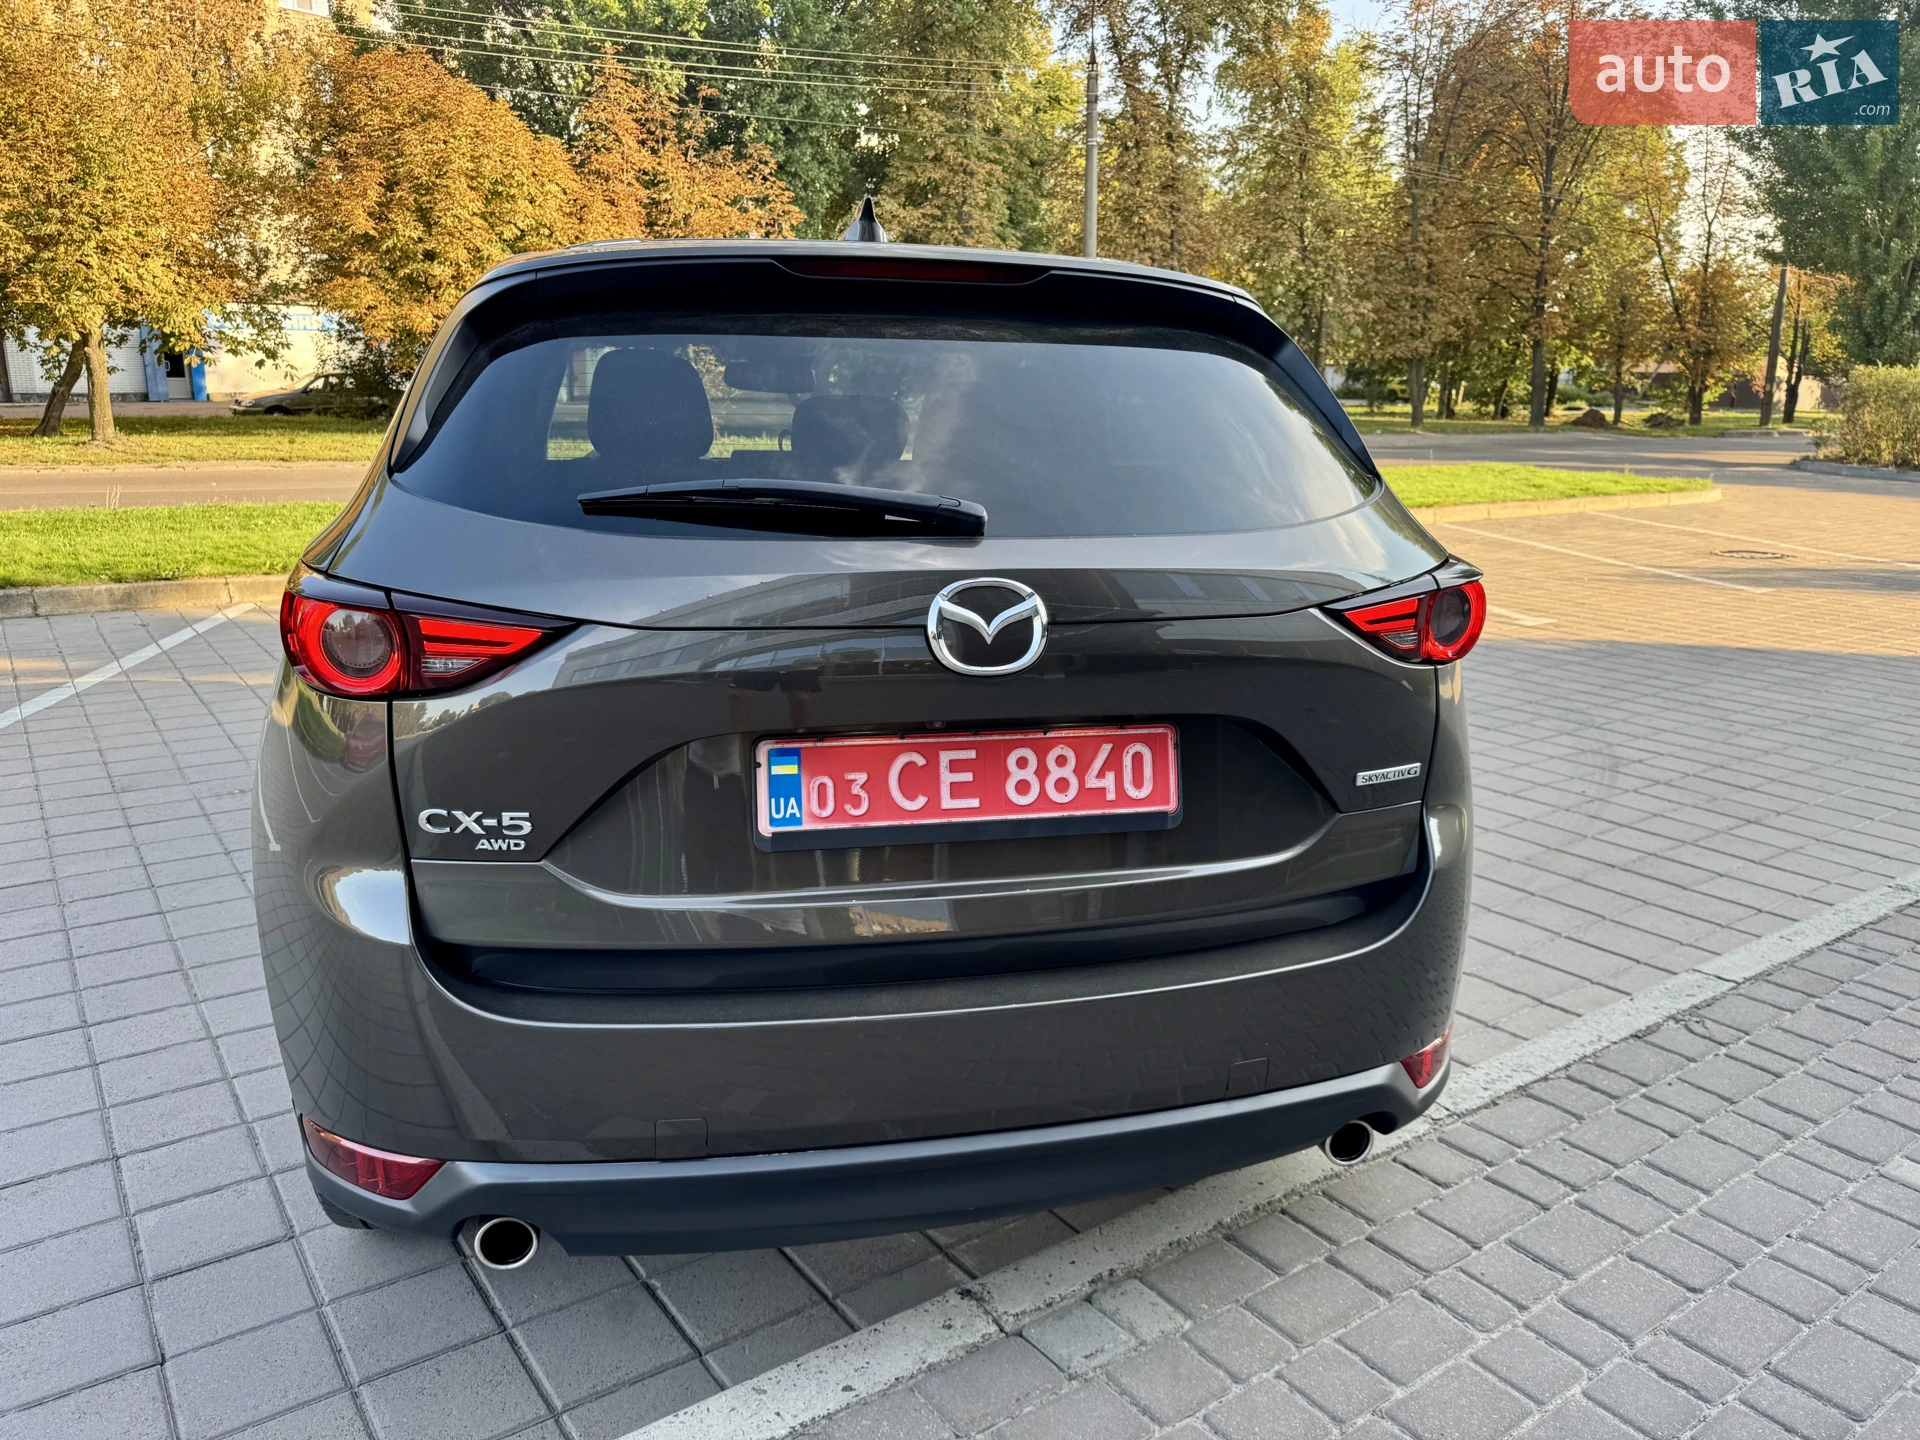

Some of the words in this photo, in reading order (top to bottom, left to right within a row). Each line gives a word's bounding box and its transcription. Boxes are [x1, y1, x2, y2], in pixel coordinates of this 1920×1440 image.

[771, 797, 800, 819] UA
[810, 772, 870, 818] 03
[888, 748, 980, 811] CE
[1005, 742, 1153, 806] 8840
[418, 808, 533, 836] CX-5
[475, 839, 526, 851] AWD
